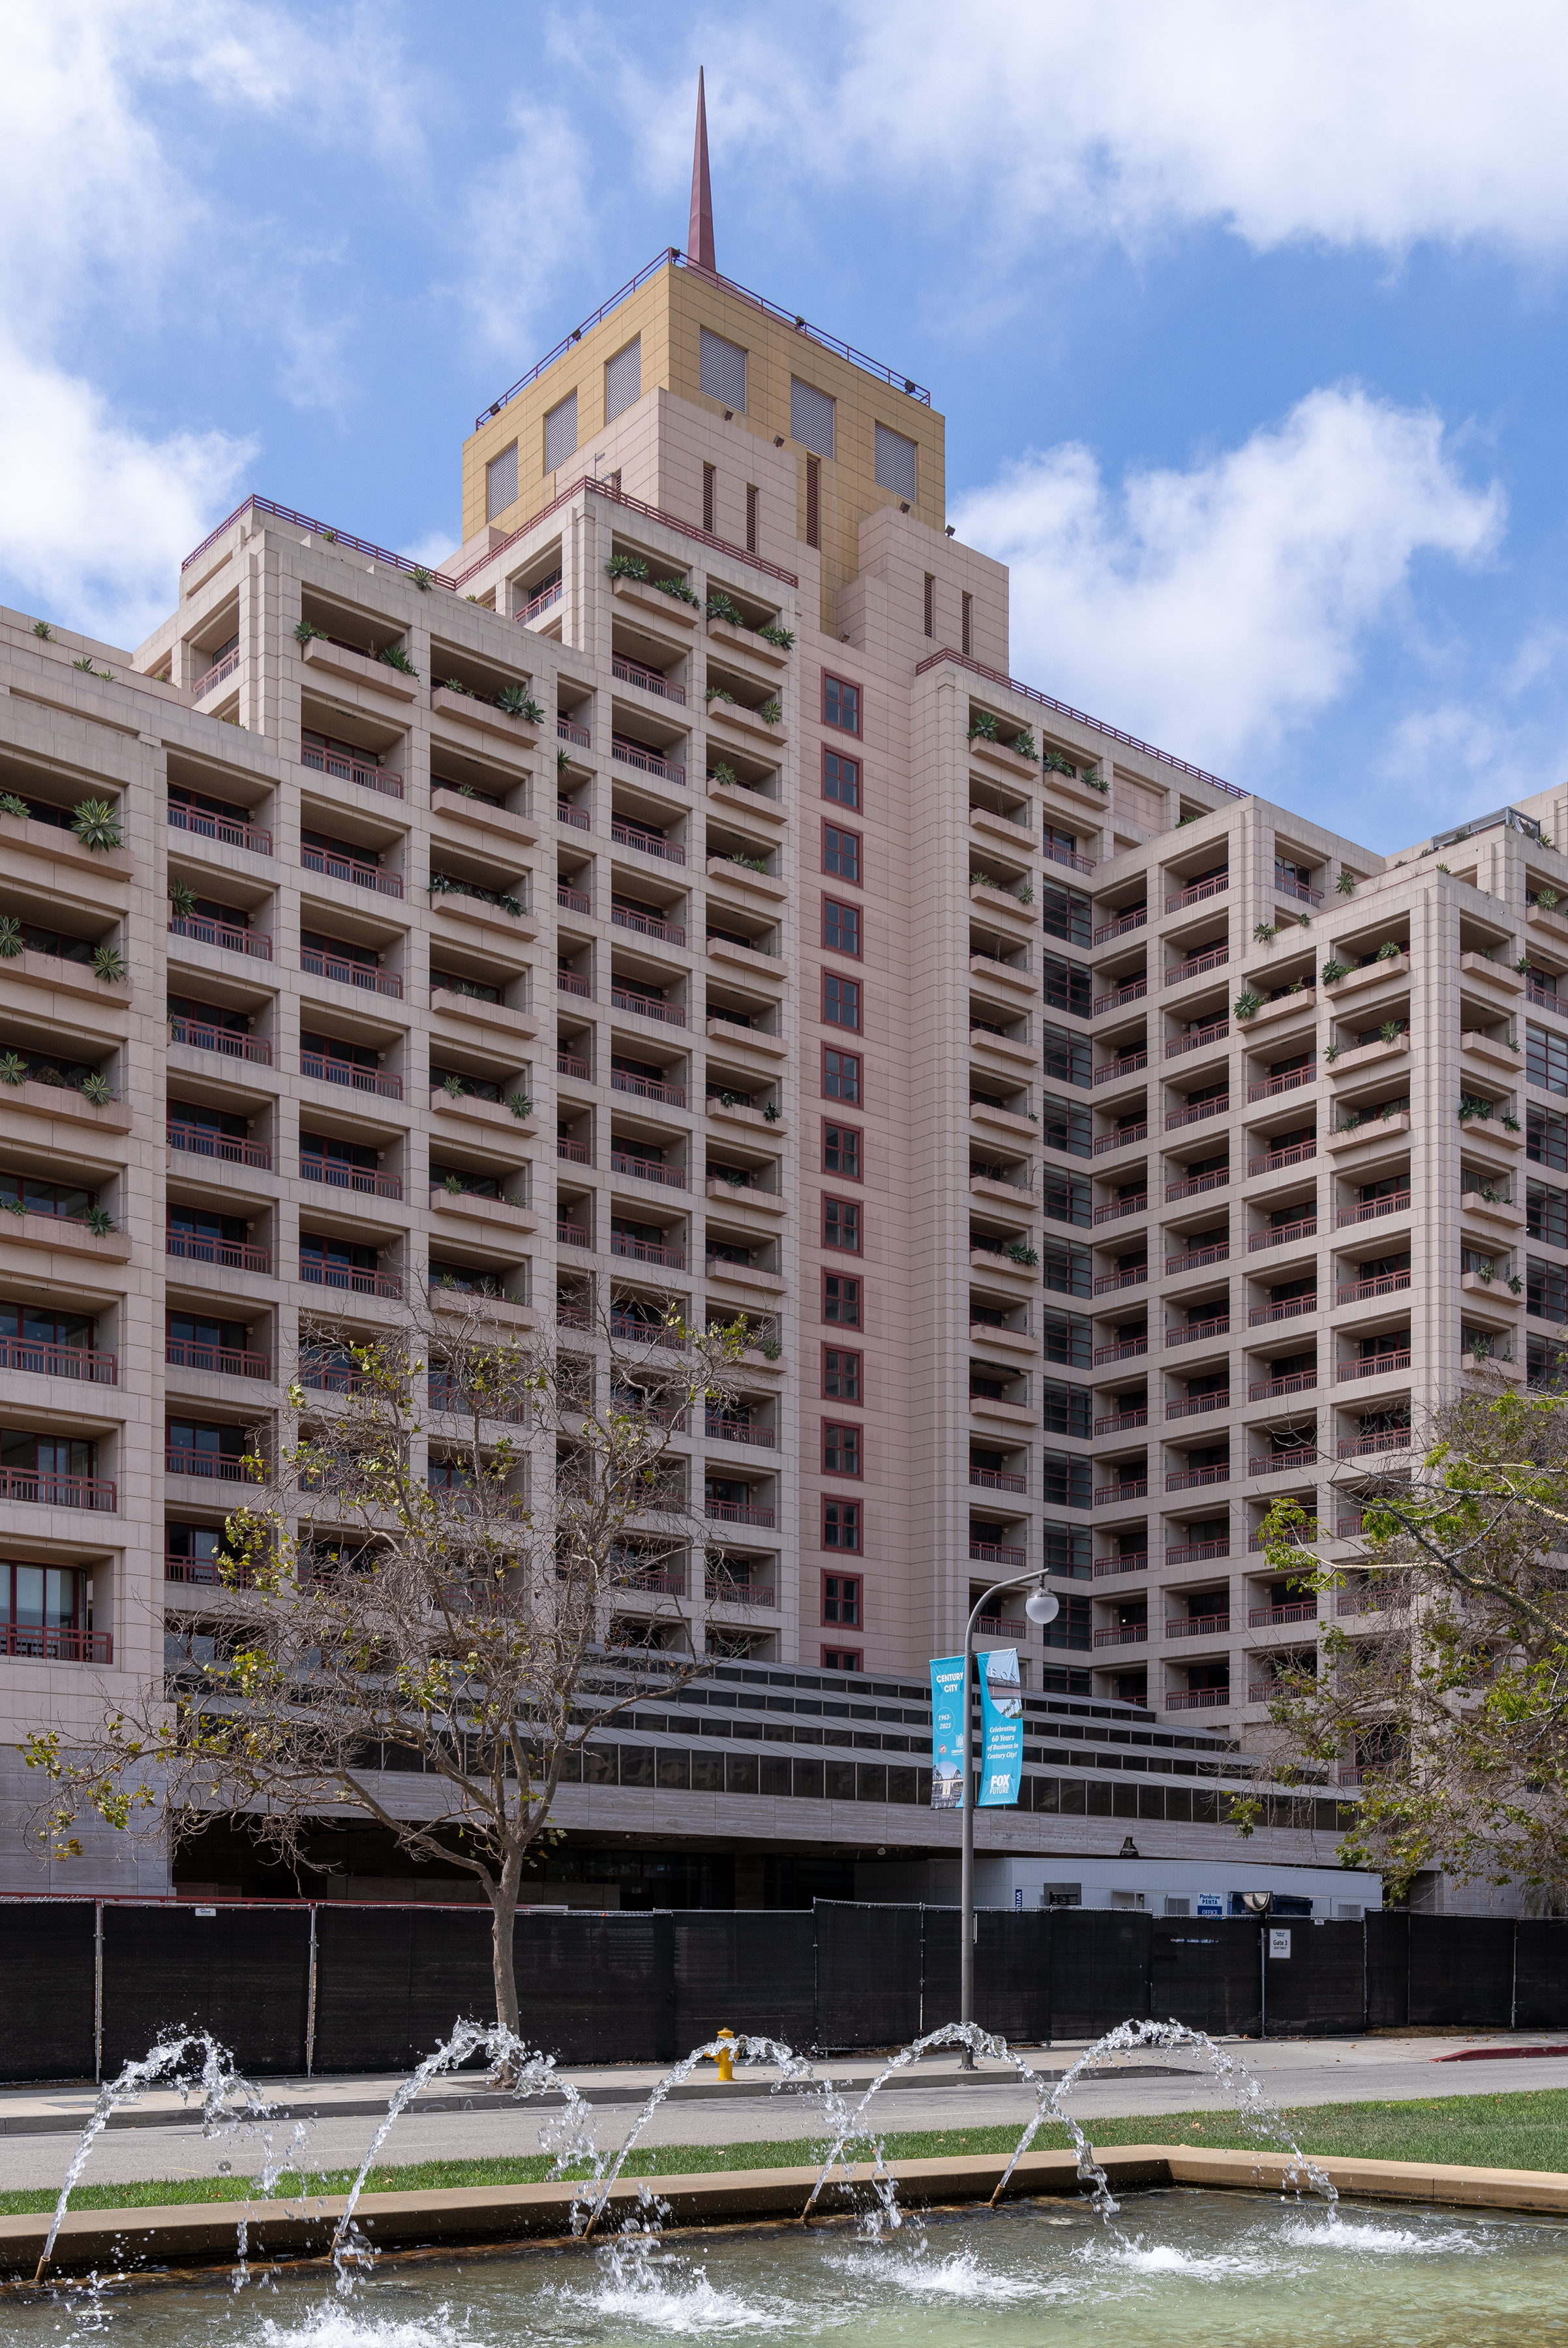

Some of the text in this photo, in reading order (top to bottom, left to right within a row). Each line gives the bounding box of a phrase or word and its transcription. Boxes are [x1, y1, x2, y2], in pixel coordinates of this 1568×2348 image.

[937, 1672, 963, 1683] CENTURY
[944, 1683, 958, 1693] CITY
[991, 1774, 1010, 1787] FOX
